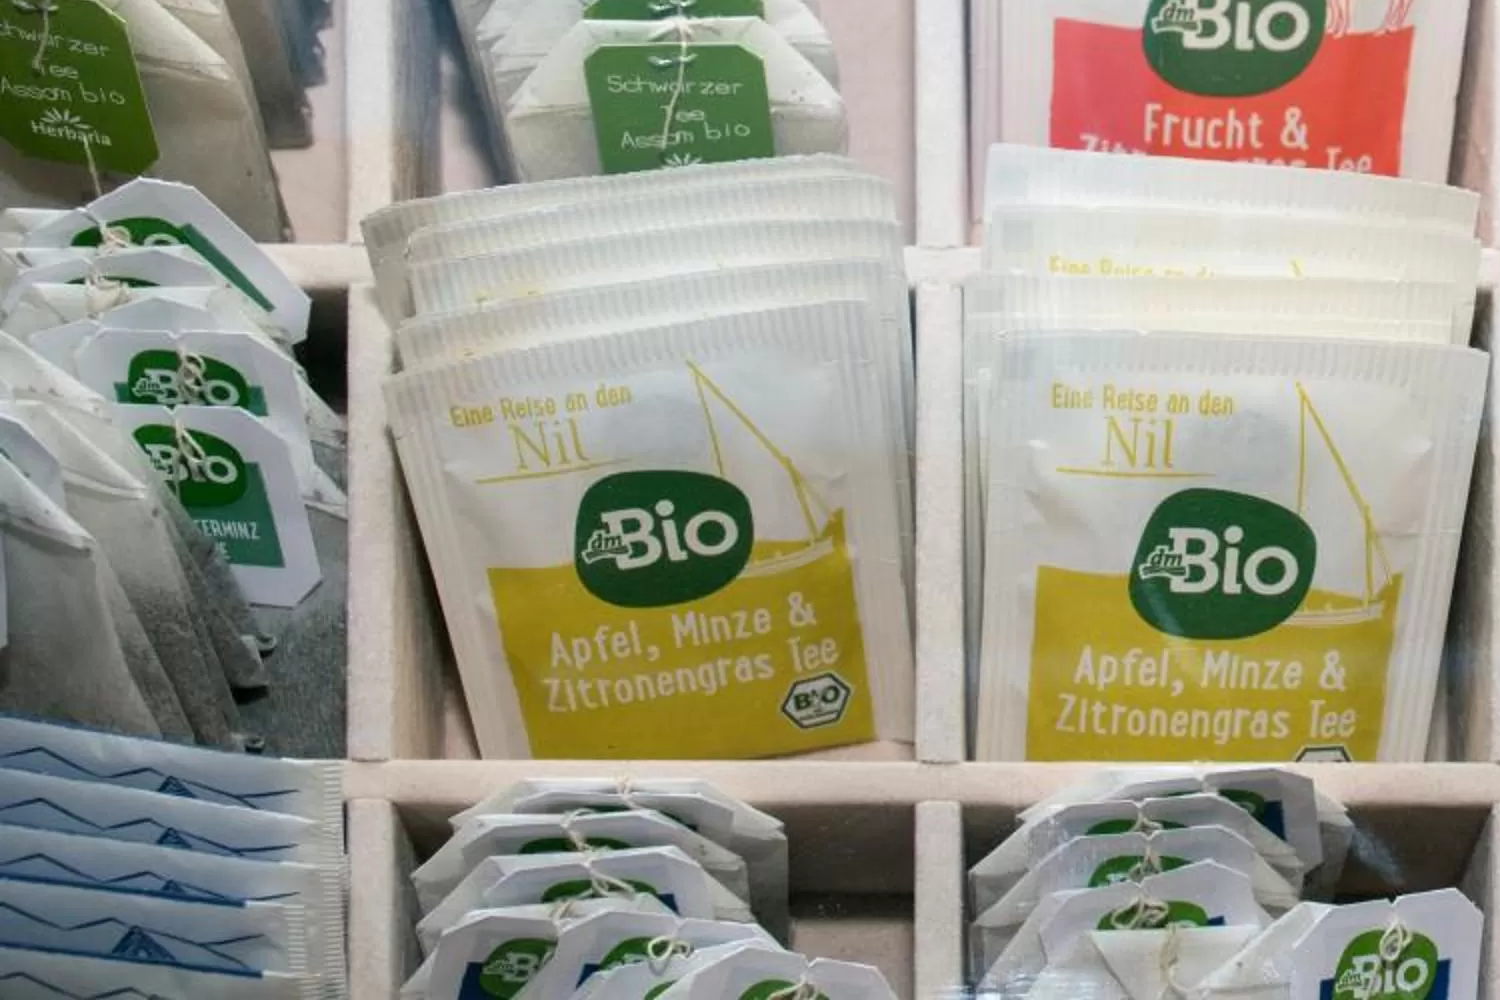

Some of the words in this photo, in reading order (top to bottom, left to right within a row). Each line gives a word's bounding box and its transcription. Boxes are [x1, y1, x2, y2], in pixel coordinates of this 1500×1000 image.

[1143, 103, 1264, 149] Frucht
[1280, 106, 1309, 150] &
[450, 405, 493, 427] Eine
[500, 396, 556, 420] Reise
[565, 392, 588, 412] an
[595, 383, 632, 408] den
[1051, 383, 1093, 410] Eine
[1102, 384, 1158, 412] Reise
[1166, 392, 1191, 413] an
[1198, 394, 1234, 416] den
[509, 418, 589, 472] Nil
[1102, 415, 1174, 468] Nil
[602, 500, 739, 571] Bio
[1168, 525, 1298, 596] Bio
[550, 620, 660, 670] Apfel,
[671, 607, 772, 649] Minze
[788, 592, 816, 627] &
[543, 652, 774, 712] Zitronengras
[786, 636, 840, 673] Tee
[1074, 644, 1185, 696] Apfel,
[1200, 649, 1303, 689] Minze
[1318, 650, 1347, 692] &
[1055, 693, 1291, 745] Zitronengras
[1309, 699, 1357, 738] Tee
